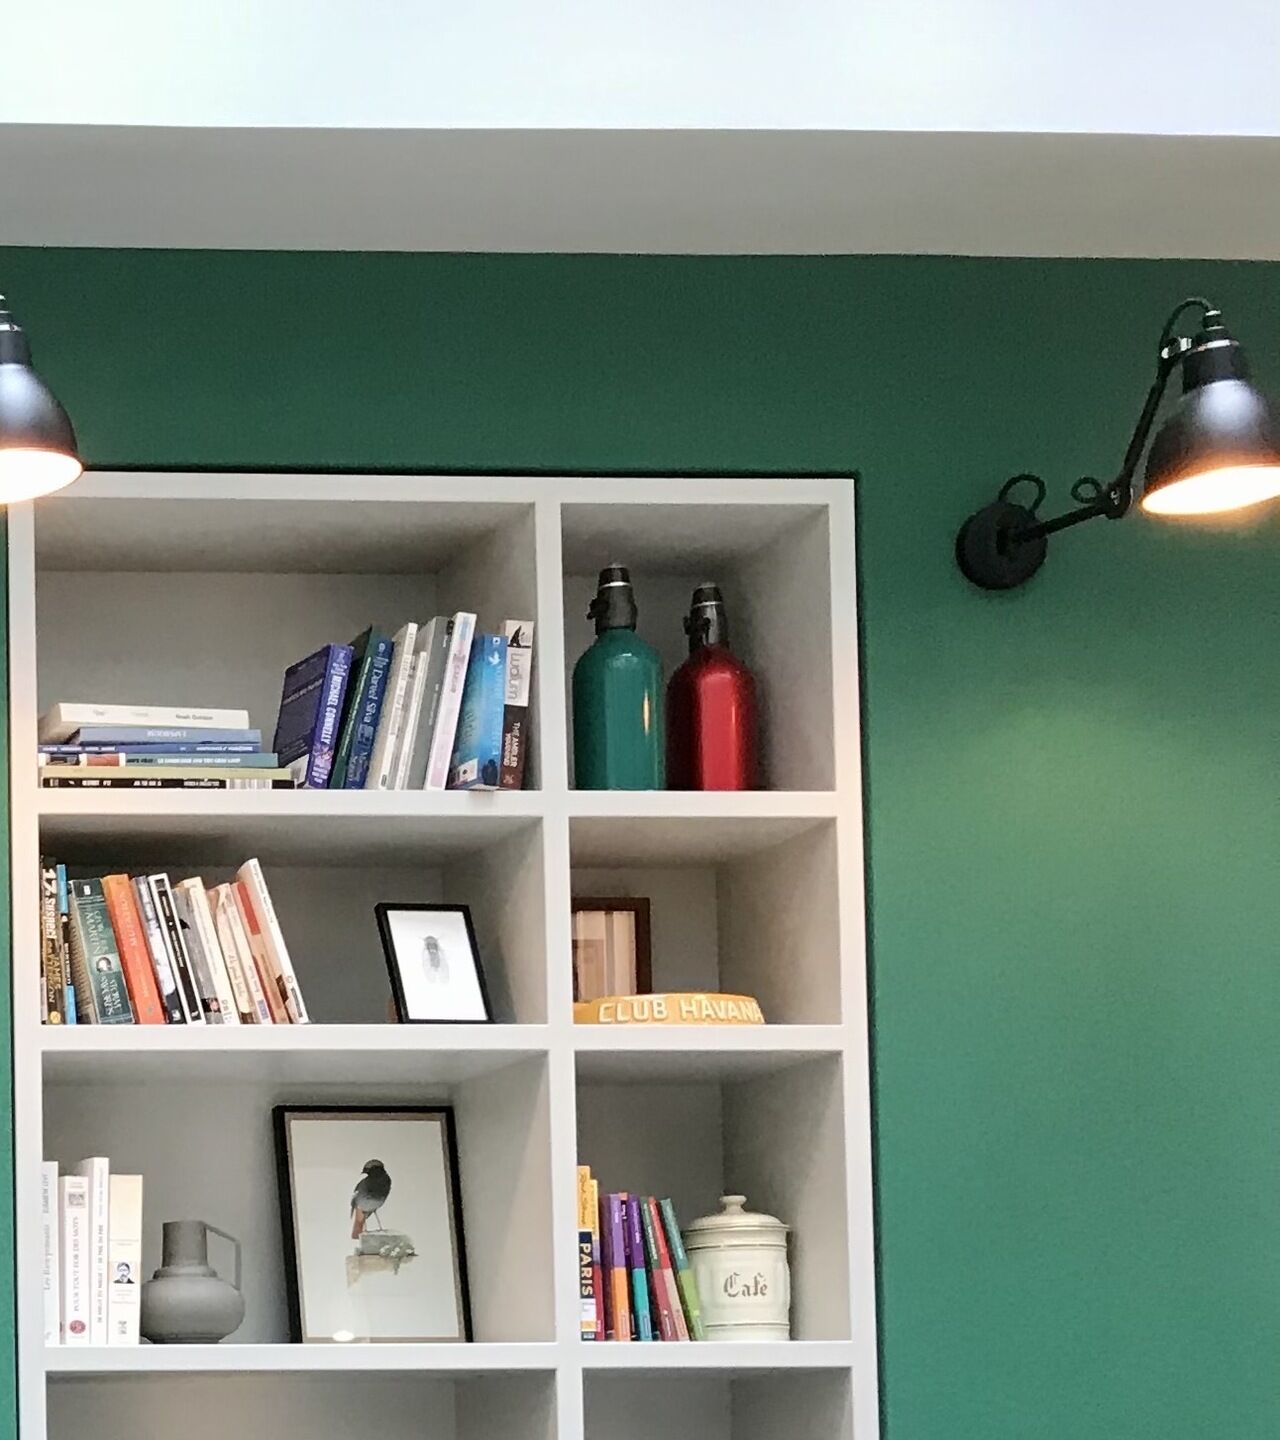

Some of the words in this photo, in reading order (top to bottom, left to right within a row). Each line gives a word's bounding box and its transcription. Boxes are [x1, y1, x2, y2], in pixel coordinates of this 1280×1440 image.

[327, 669, 344, 707] MICHAEL
[320, 707, 337, 745] CONNELLY
[599, 999, 668, 1023] CLUB
[680, 1000, 766, 1024] HAVANA
[579, 1243, 593, 1297] PARIS
[723, 1271, 769, 1298] Café
